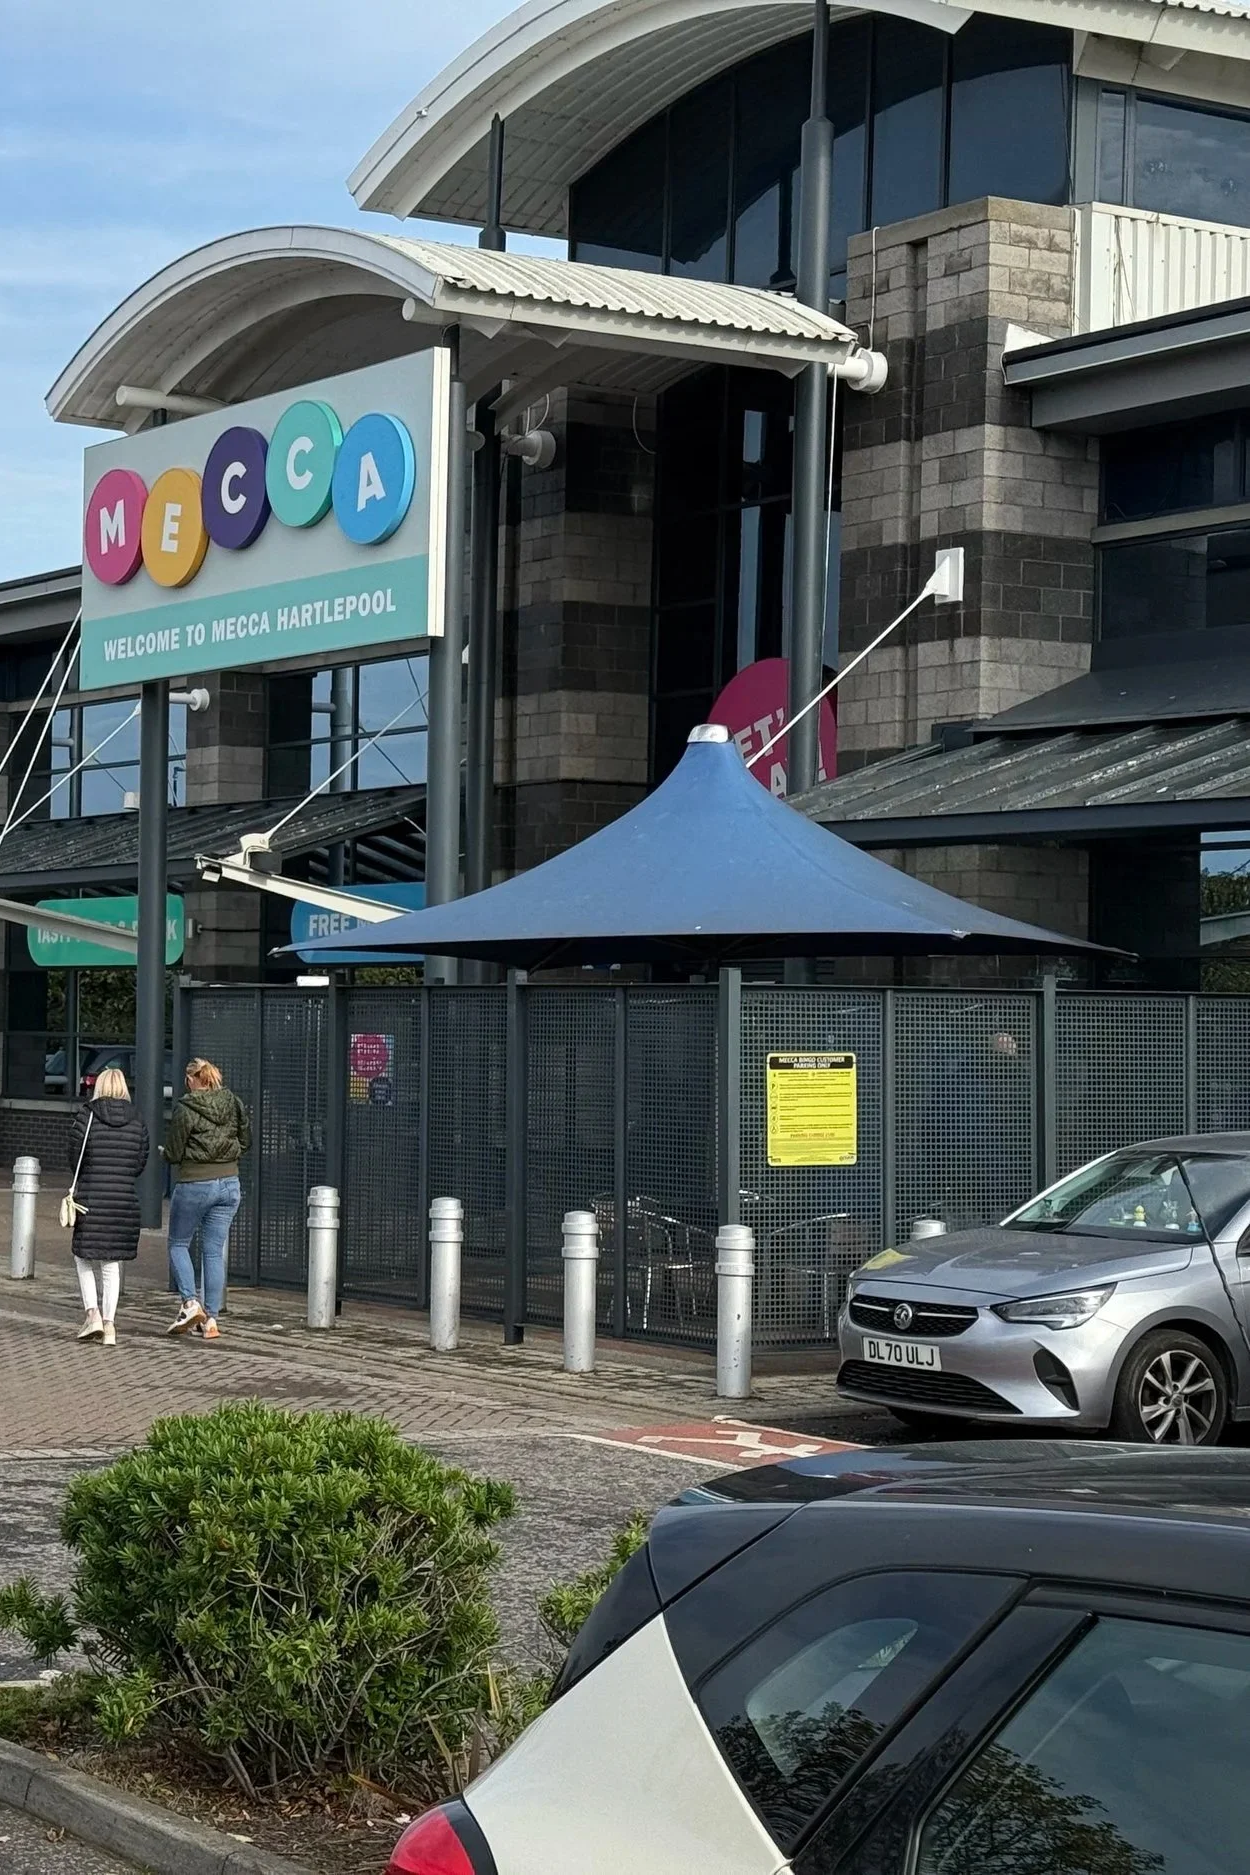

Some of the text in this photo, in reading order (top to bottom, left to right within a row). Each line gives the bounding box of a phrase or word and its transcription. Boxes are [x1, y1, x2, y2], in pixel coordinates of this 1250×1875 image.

[100, 436, 387, 556] MECCA
[104, 588, 397, 661] WELCOME TO MECCA HARTLEPOOL
[308, 913, 350, 937] FREE
[869, 1340, 935, 1367] DL70 ULJ
